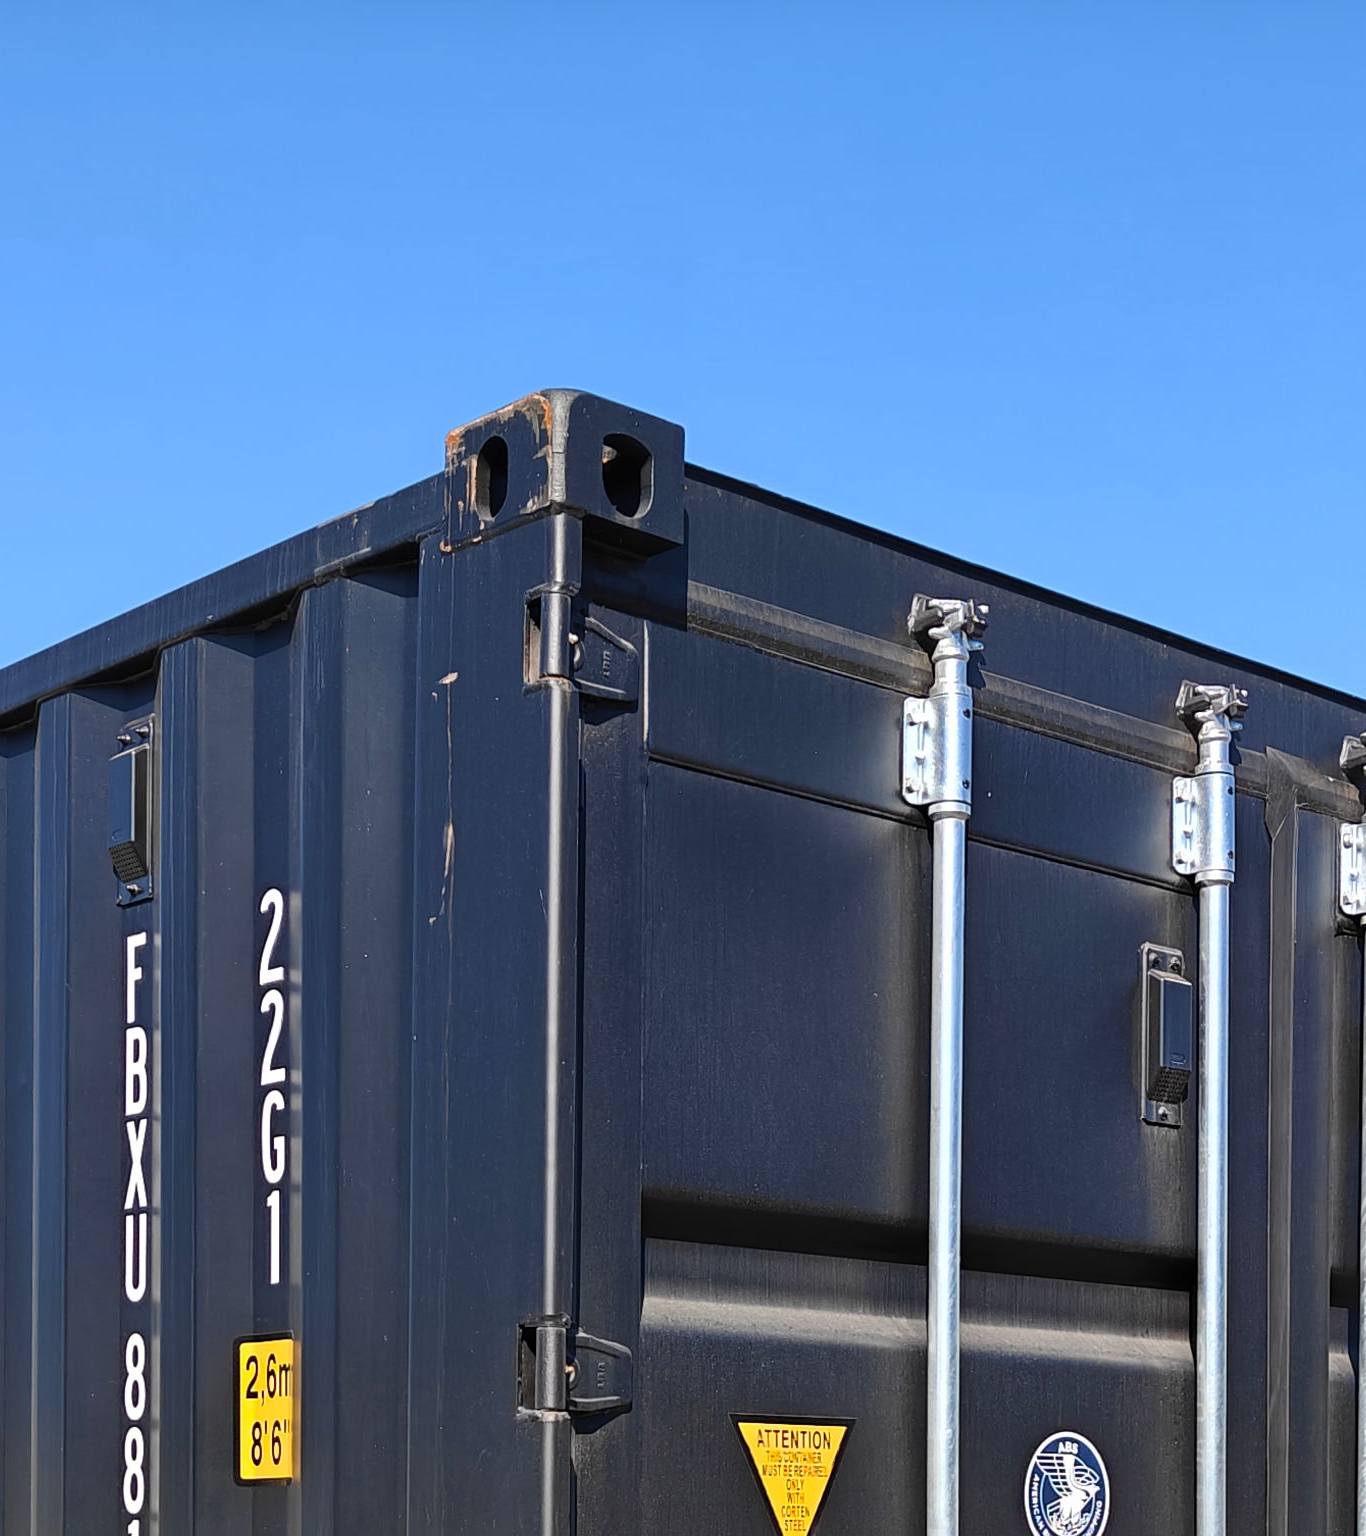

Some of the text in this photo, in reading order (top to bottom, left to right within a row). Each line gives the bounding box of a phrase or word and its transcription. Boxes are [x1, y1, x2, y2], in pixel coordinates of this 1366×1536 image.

[258, 888, 286, 1286] 22G1
[123, 931, 148, 1303] FBXU
[756, 1428, 832, 1450] ATTENTION
[1057, 1441, 1079, 1454] ABS
[762, 1464, 782, 1477] MUST
[783, 1464, 793, 1478] BE
[786, 1478, 805, 1491] ONLY
[786, 1492, 805, 1504] WITH
[1030, 1473, 1046, 1531] AMERICAN
[781, 1505, 810, 1518] CORTEN
[784, 1519, 807, 1532] STEEL
